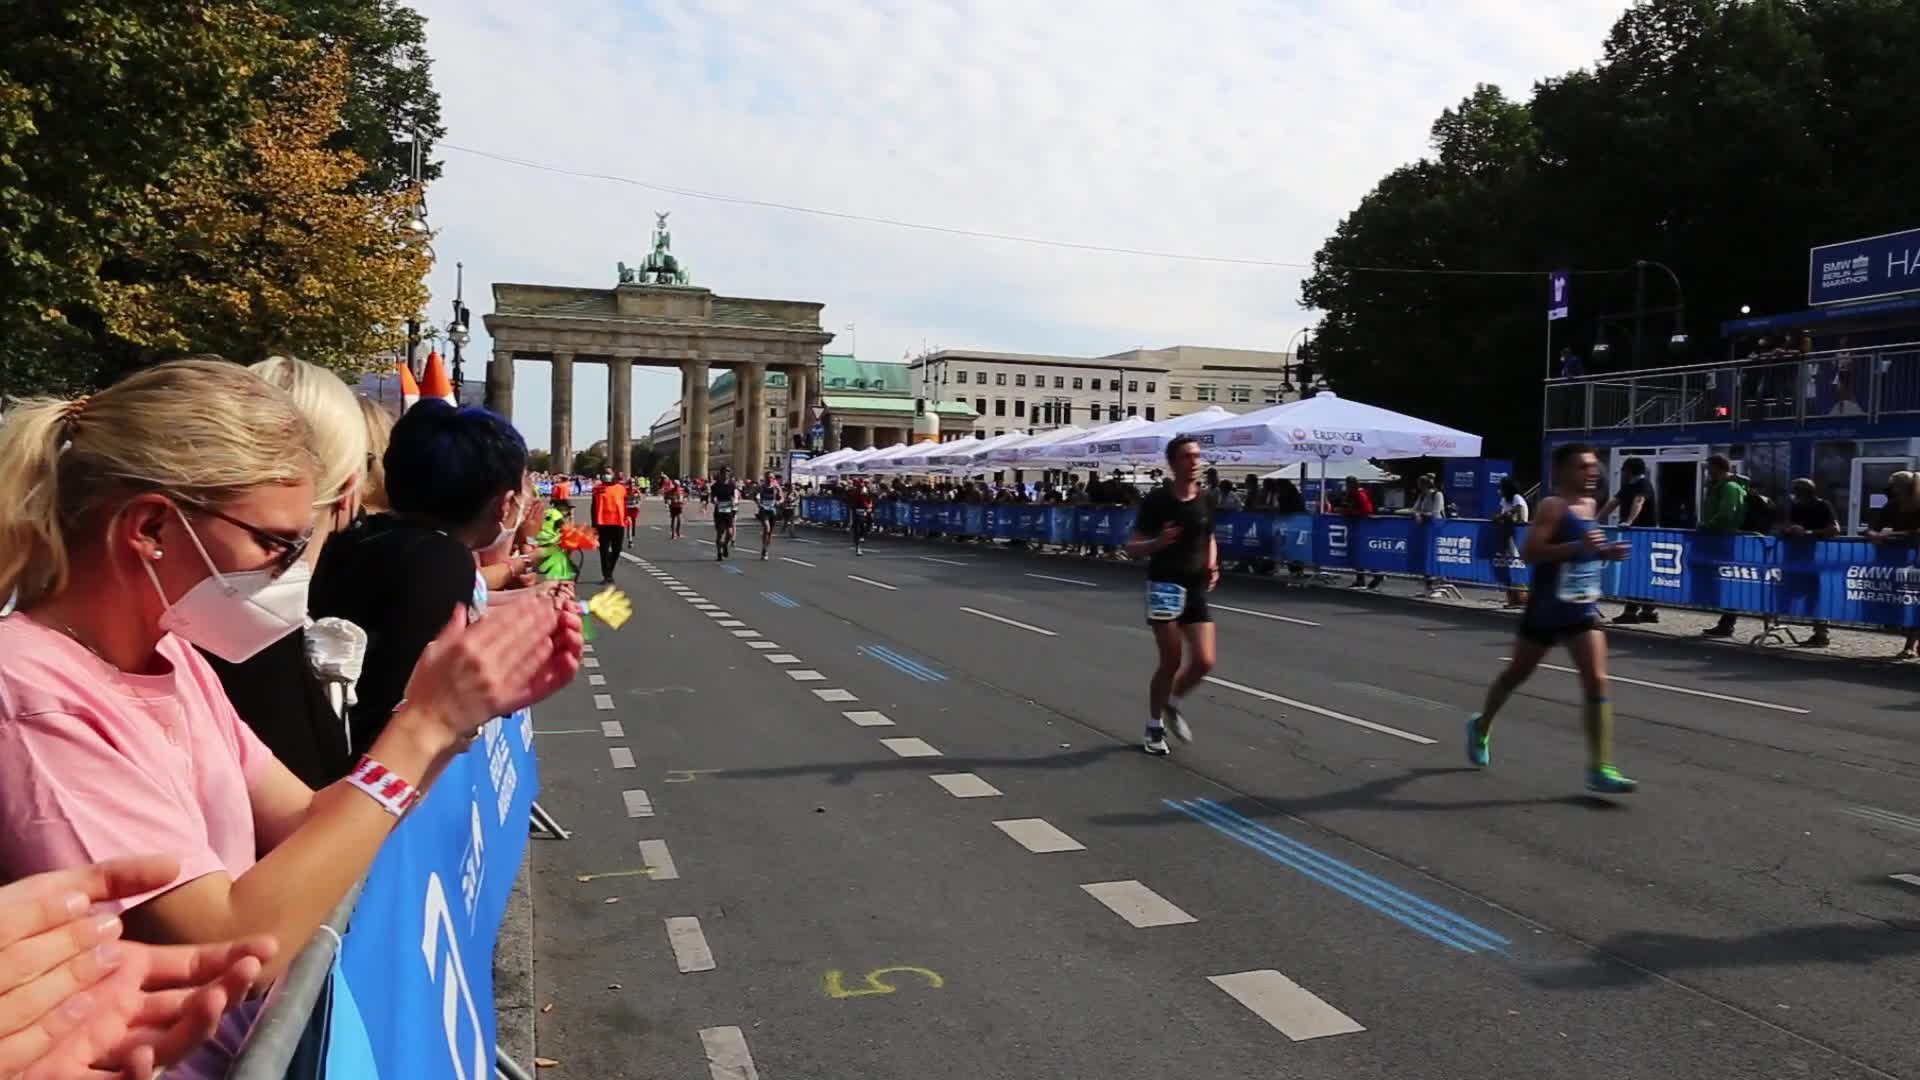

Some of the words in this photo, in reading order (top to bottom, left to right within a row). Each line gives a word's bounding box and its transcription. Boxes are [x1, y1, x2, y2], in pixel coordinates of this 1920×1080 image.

[1823, 260, 1852, 273] BMW
[1368, 539, 1392, 550] Giti
[1718, 564, 1759, 581] Giti
[1846, 565, 1894, 580] BMW
[1846, 578, 1893, 592] BERLIN
